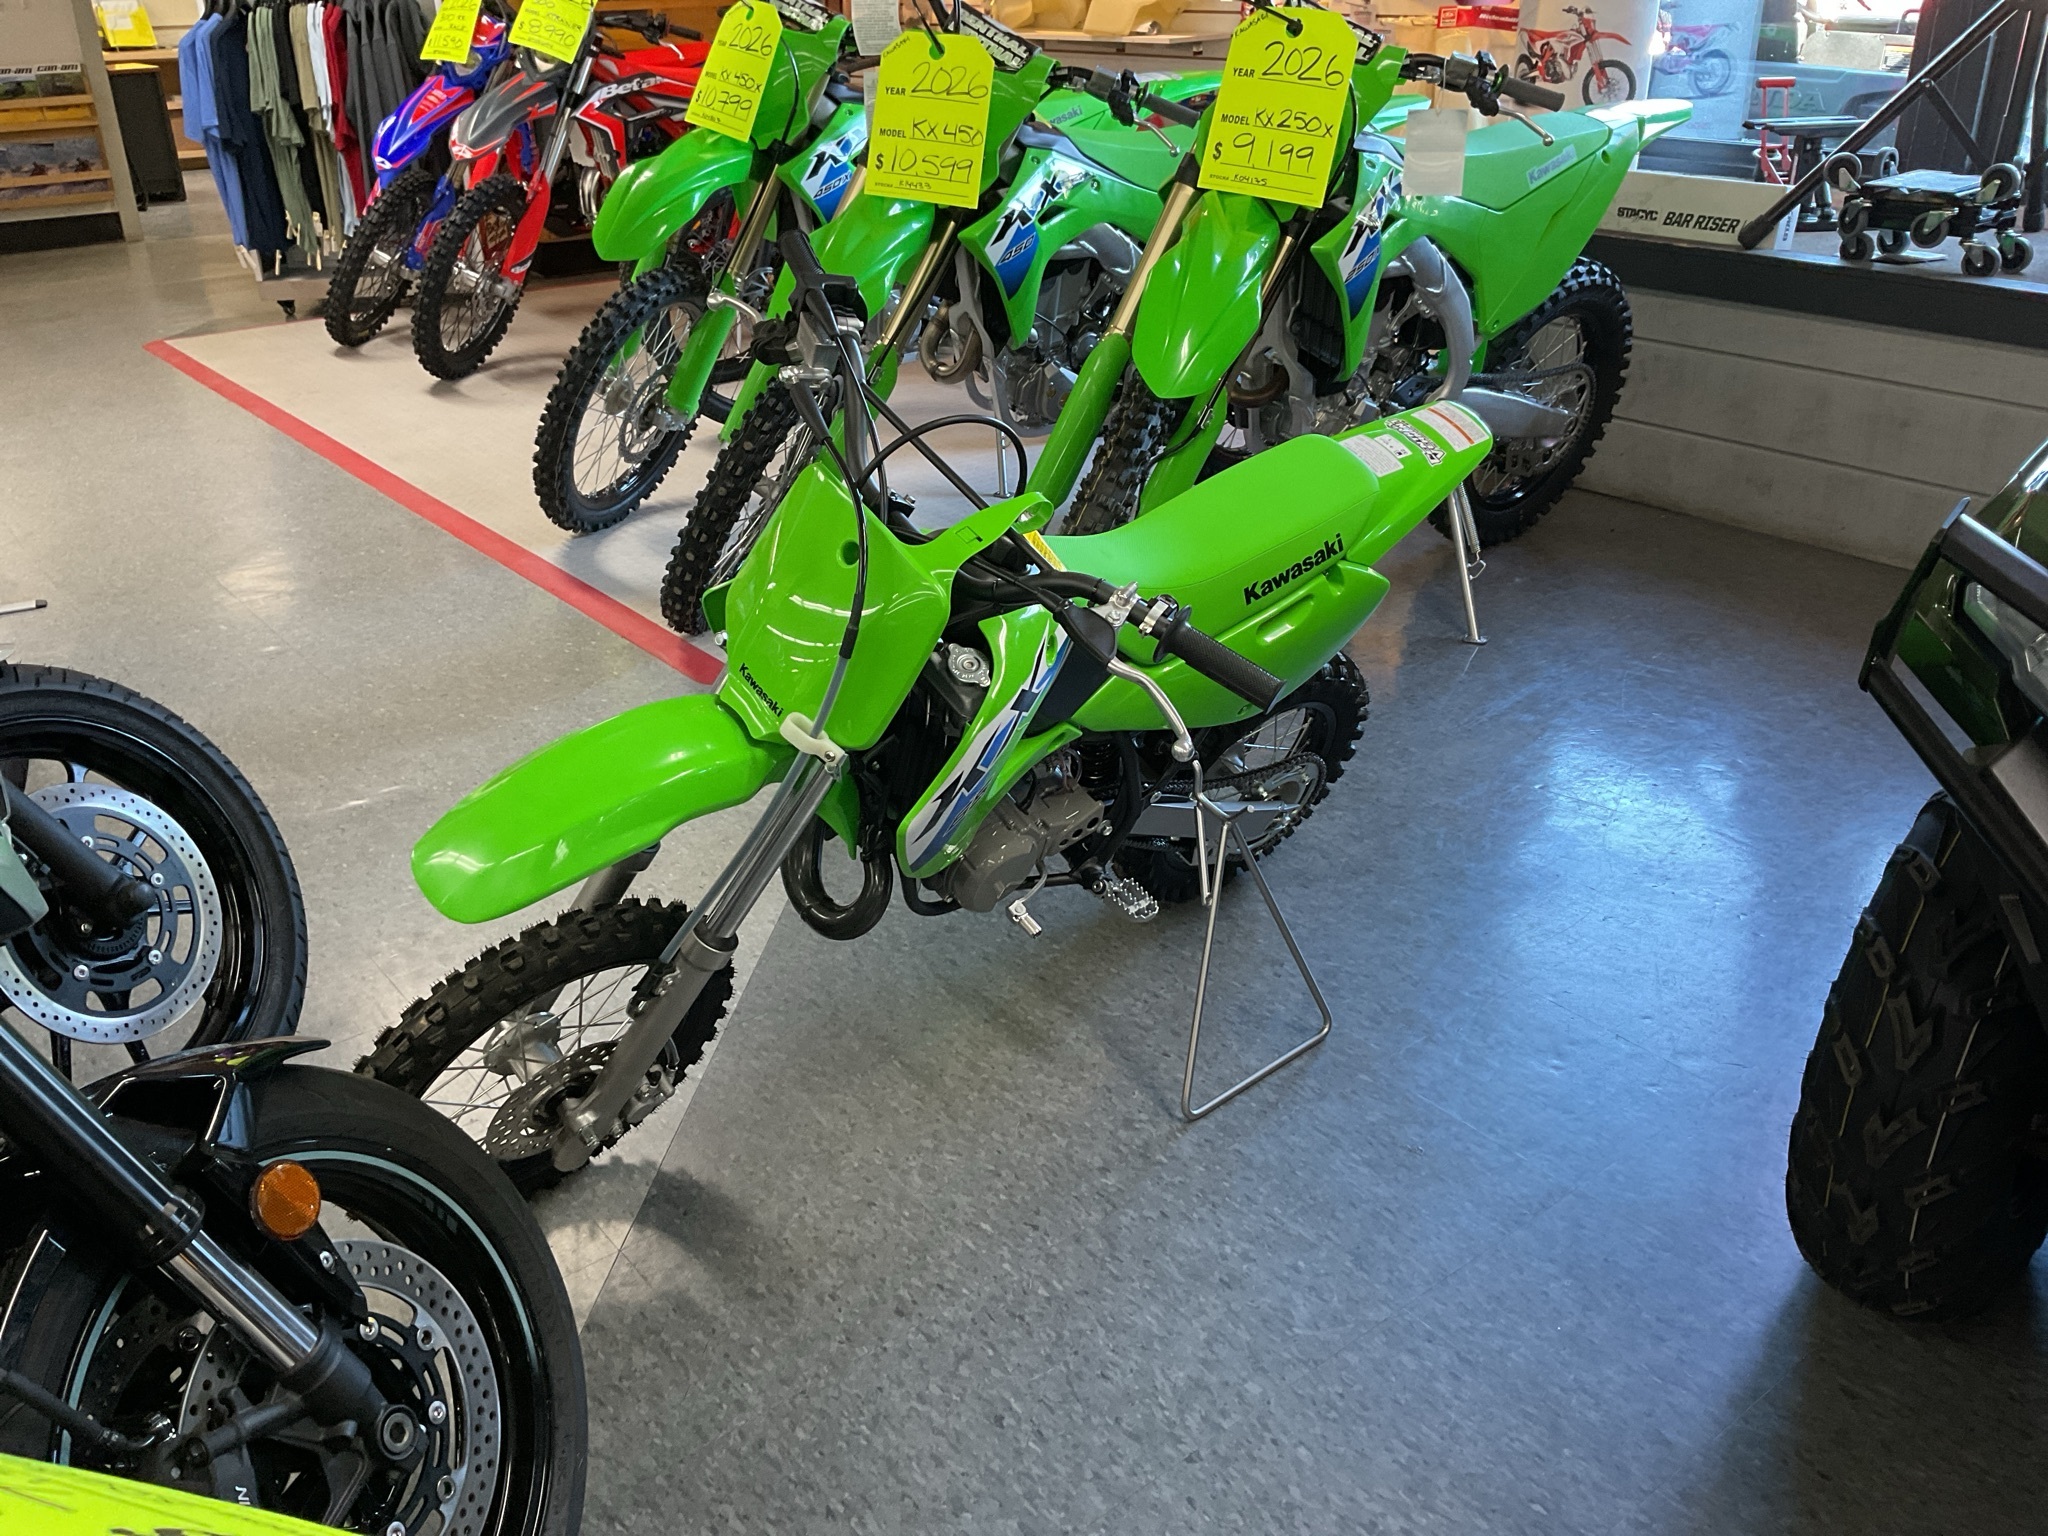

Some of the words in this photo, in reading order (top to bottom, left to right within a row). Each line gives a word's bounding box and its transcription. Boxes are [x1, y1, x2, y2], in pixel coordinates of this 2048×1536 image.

[728, 23, 773, 57] 2026
[885, 86, 906, 96] YEAR
[911, 61, 989, 99] 2026
[1232, 67, 1256, 79] YEAR
[1261, 41, 1345, 87] 2026
[601, 76, 657, 98] Beta
[879, 127, 907, 139] MODEL
[1220, 113, 1250, 126] MODEL
[1617, 207, 1658, 221] STACYC
[1662, 211, 1693, 229] BAR
[1693, 215, 1740, 233] RISER
[998, 233, 1036, 264] 450
[1243, 532, 1344, 606] Kawasaki
[739, 662, 784, 718] Kawasaki
